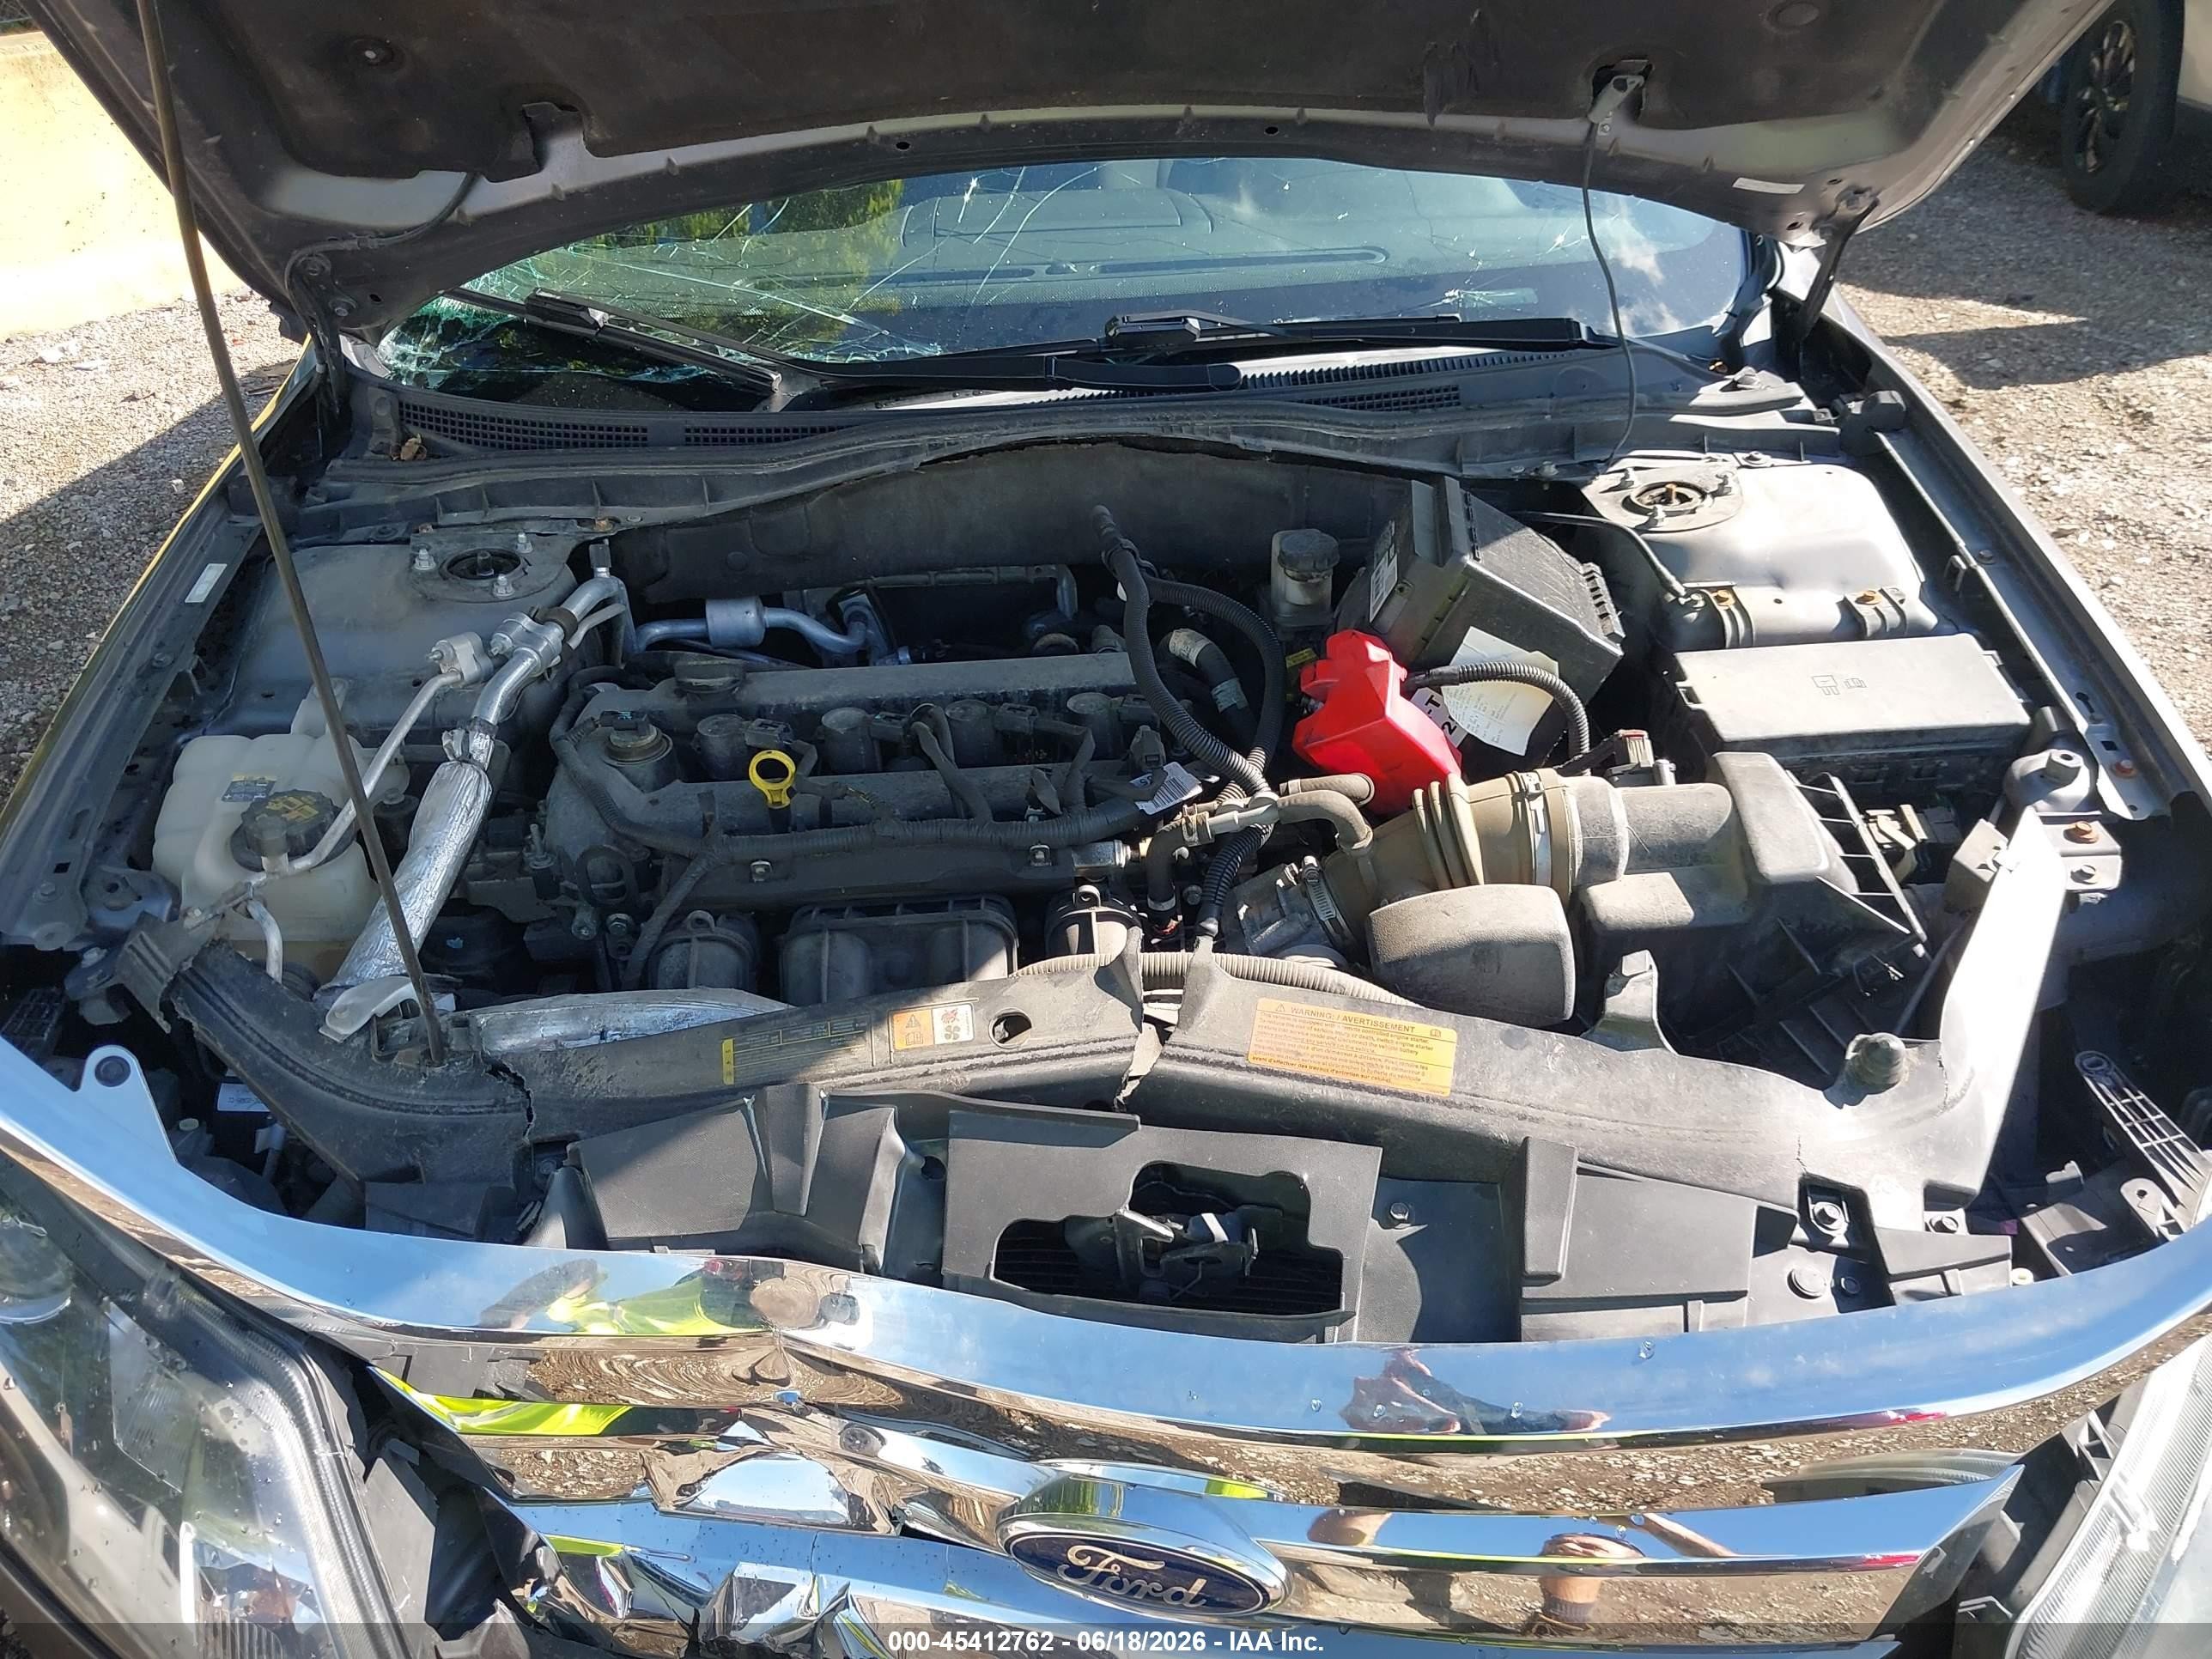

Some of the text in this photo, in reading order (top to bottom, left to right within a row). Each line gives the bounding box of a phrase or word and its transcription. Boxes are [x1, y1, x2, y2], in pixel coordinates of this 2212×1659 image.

[1441, 715, 1458, 736] 2
[1290, 1006, 1334, 1019] WARNING:
[1341, 1014, 1415, 1033] AVERTISSEMENT
[1056, 1545, 1207, 1608] Ford
